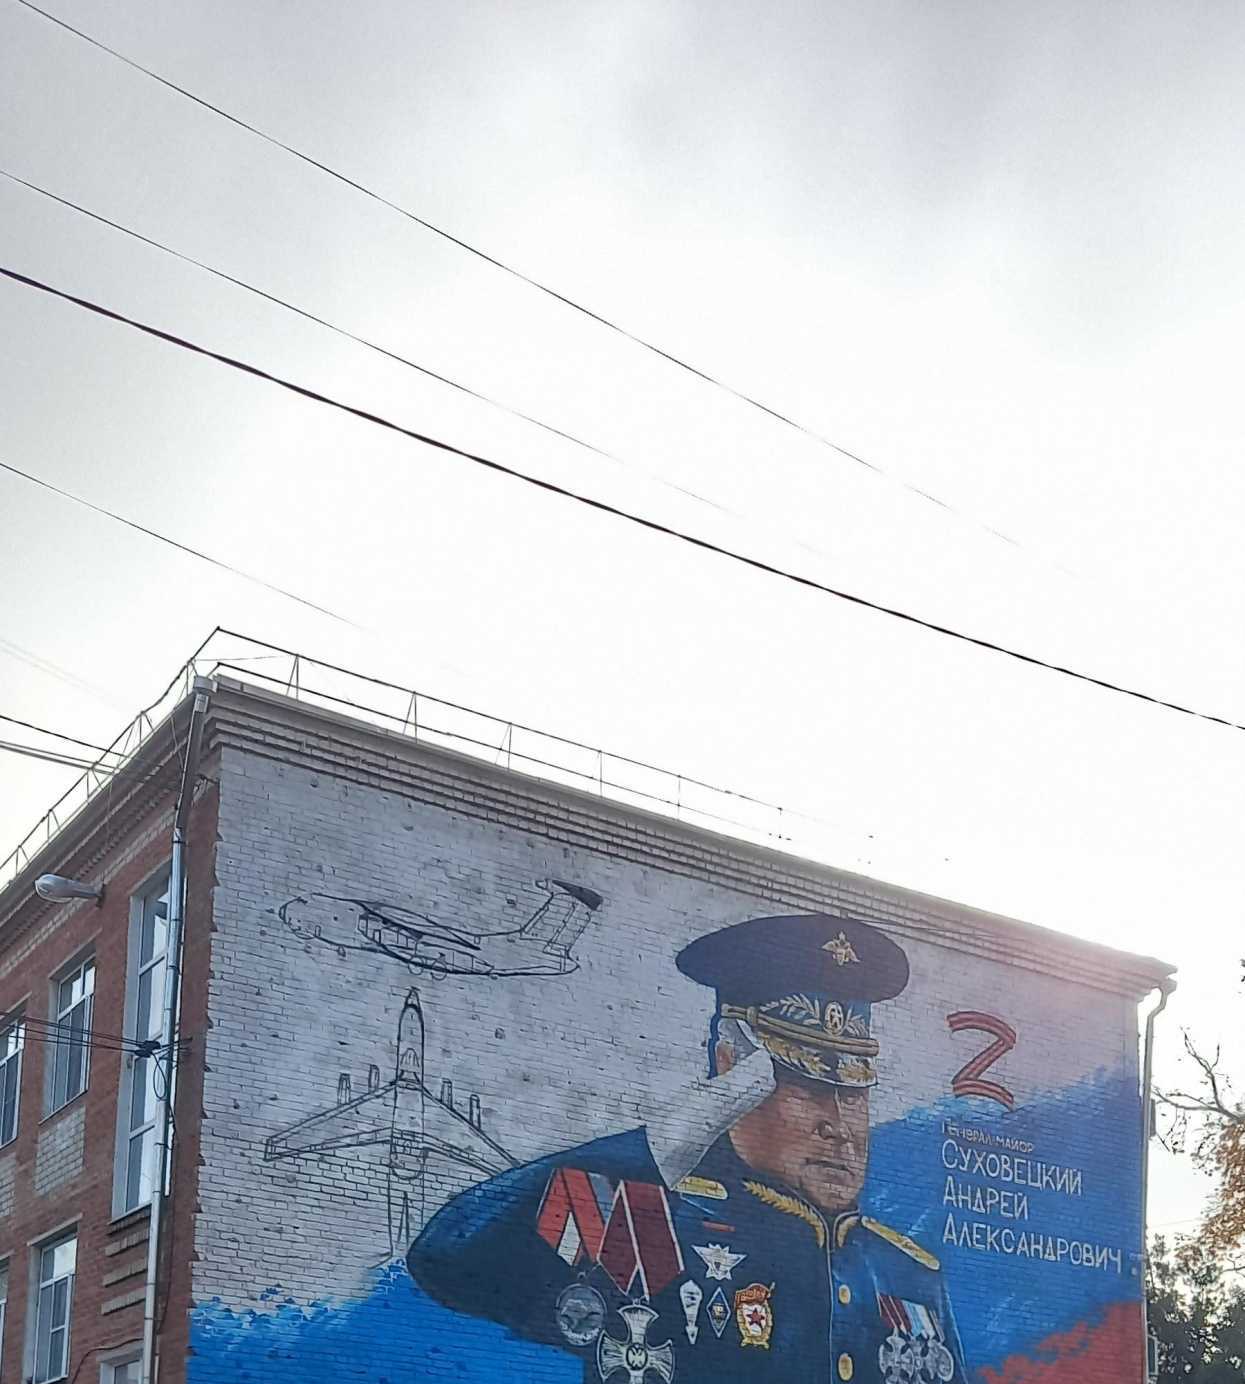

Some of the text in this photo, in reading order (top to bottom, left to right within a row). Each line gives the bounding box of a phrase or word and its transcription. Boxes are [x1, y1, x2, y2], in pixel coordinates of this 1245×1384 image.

[946, 1010, 1017, 1111] Z
[942, 1139, 1082, 1196] СУХОВЕЦКИЙ
[943, 1175, 1029, 1221] АНДРЕЙ
[943, 1212, 1122, 1273] АЛЕКСАНДРОВИЧ
